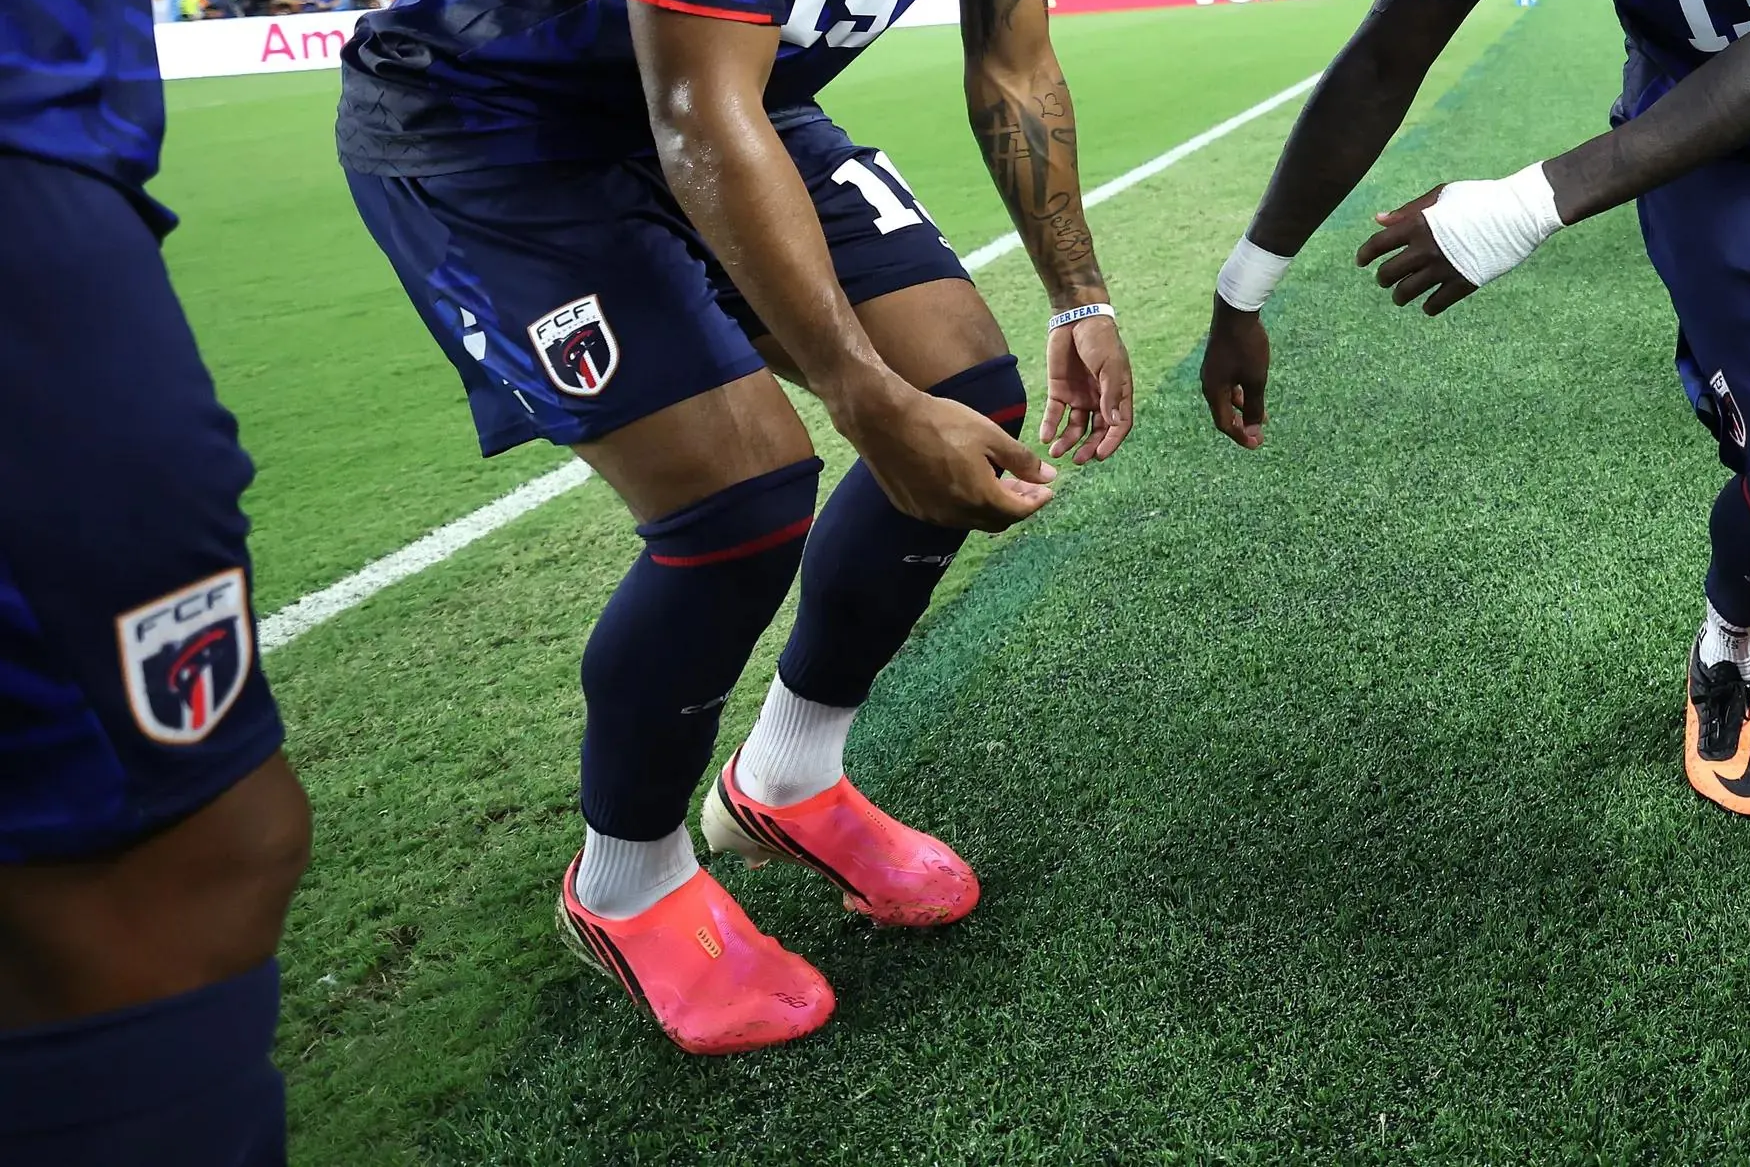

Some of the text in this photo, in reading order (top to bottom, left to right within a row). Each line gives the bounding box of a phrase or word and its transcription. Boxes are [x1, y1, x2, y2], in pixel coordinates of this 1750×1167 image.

[260, 23, 346, 63] Am
[536, 300, 592, 340] FCF
[1050, 305, 1100, 328] OVER FEAR
[135, 581, 234, 644] FCF
